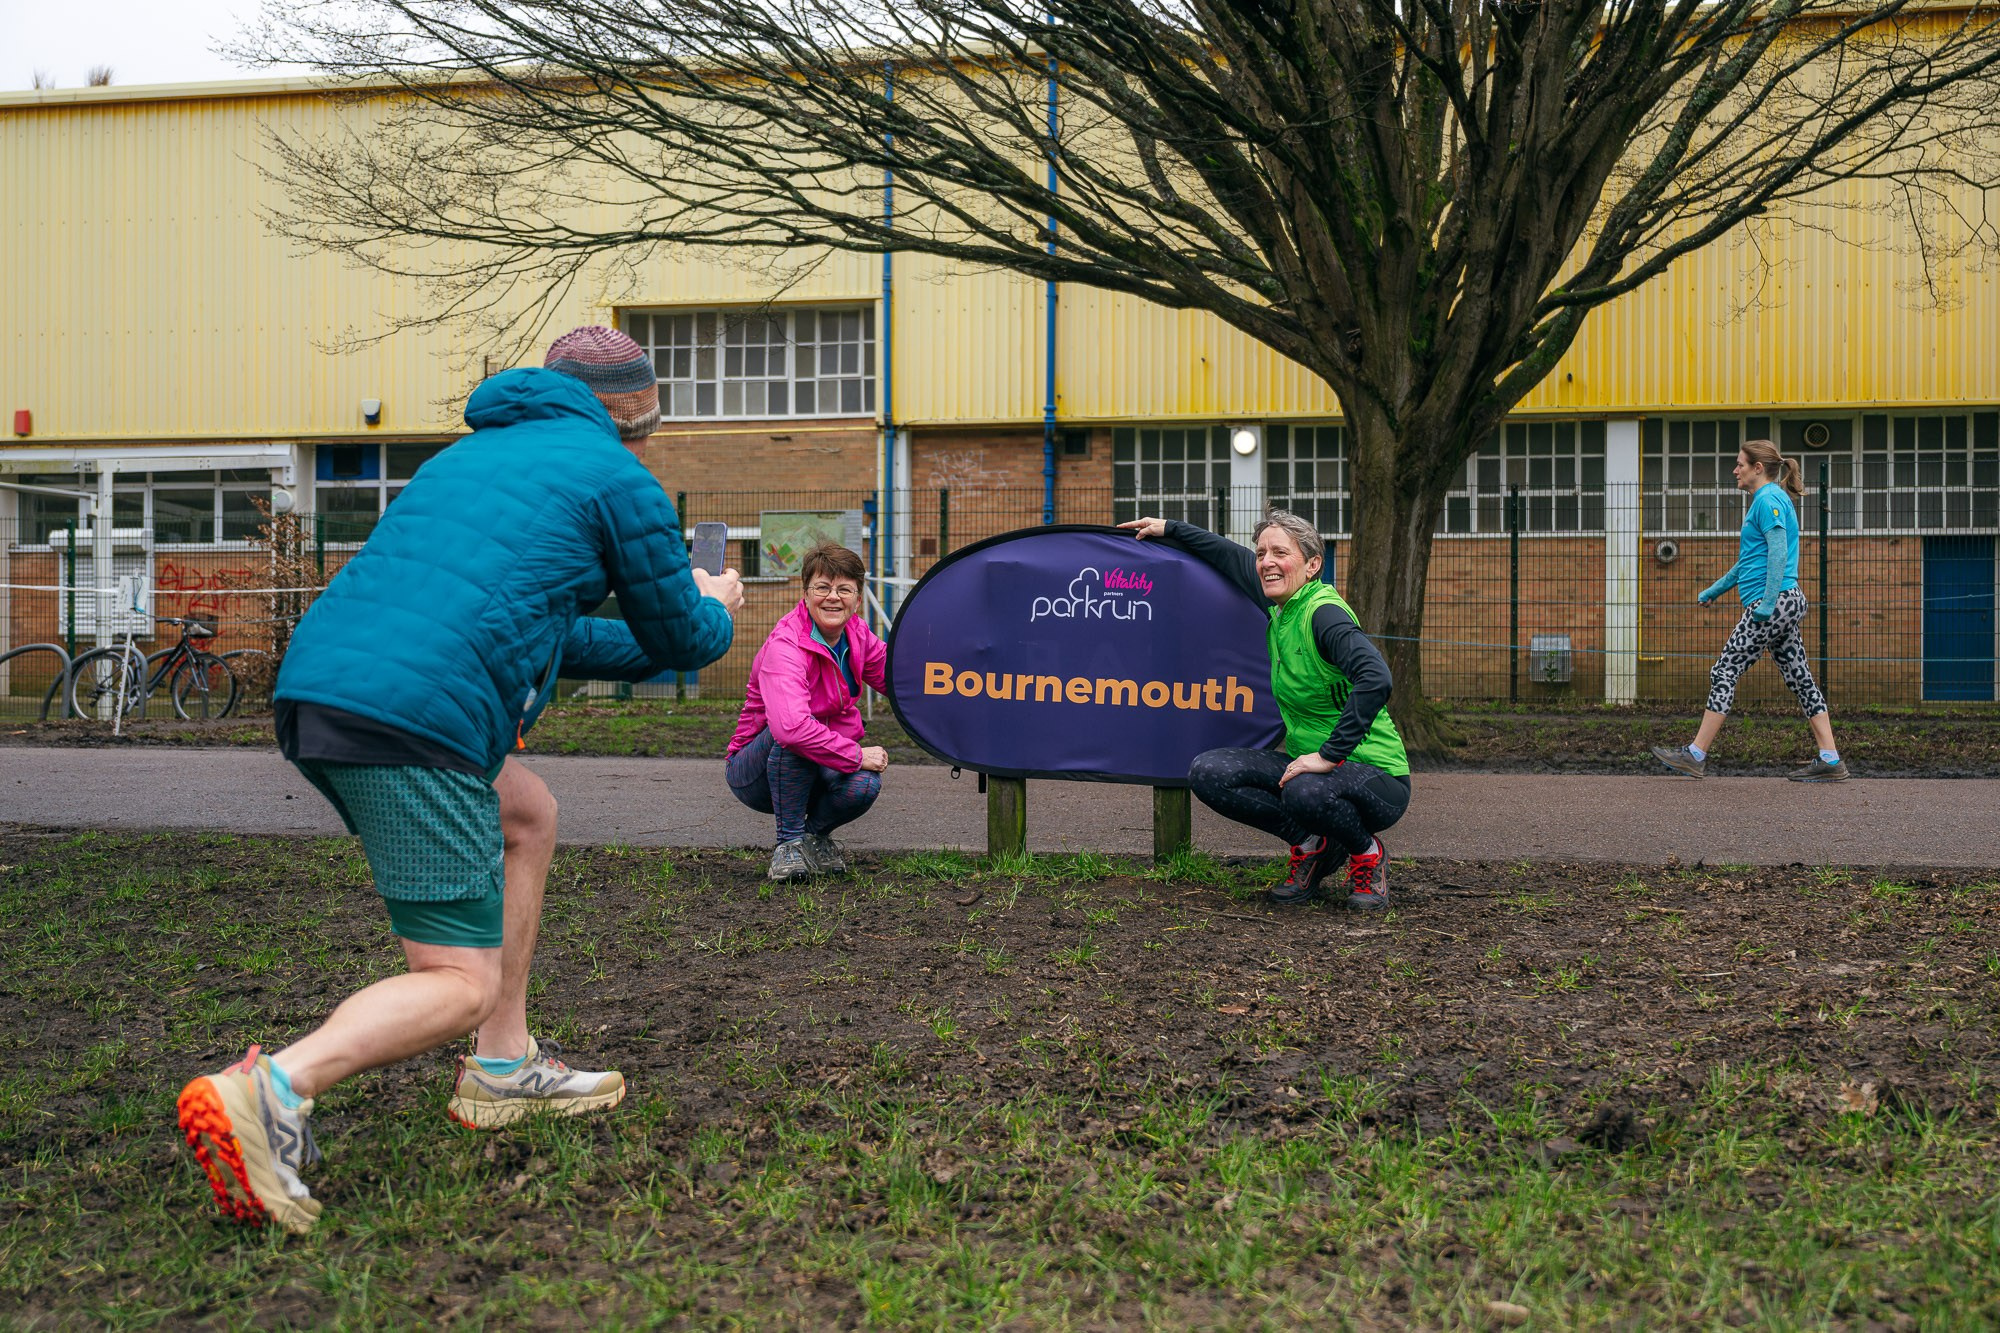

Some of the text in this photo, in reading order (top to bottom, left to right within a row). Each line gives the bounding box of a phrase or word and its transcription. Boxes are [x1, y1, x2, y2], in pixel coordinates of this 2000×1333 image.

[1104, 567, 1153, 596] Vitality
[1030, 582, 1152, 622] parkrun
[923, 661, 1255, 713] Bournemouth
